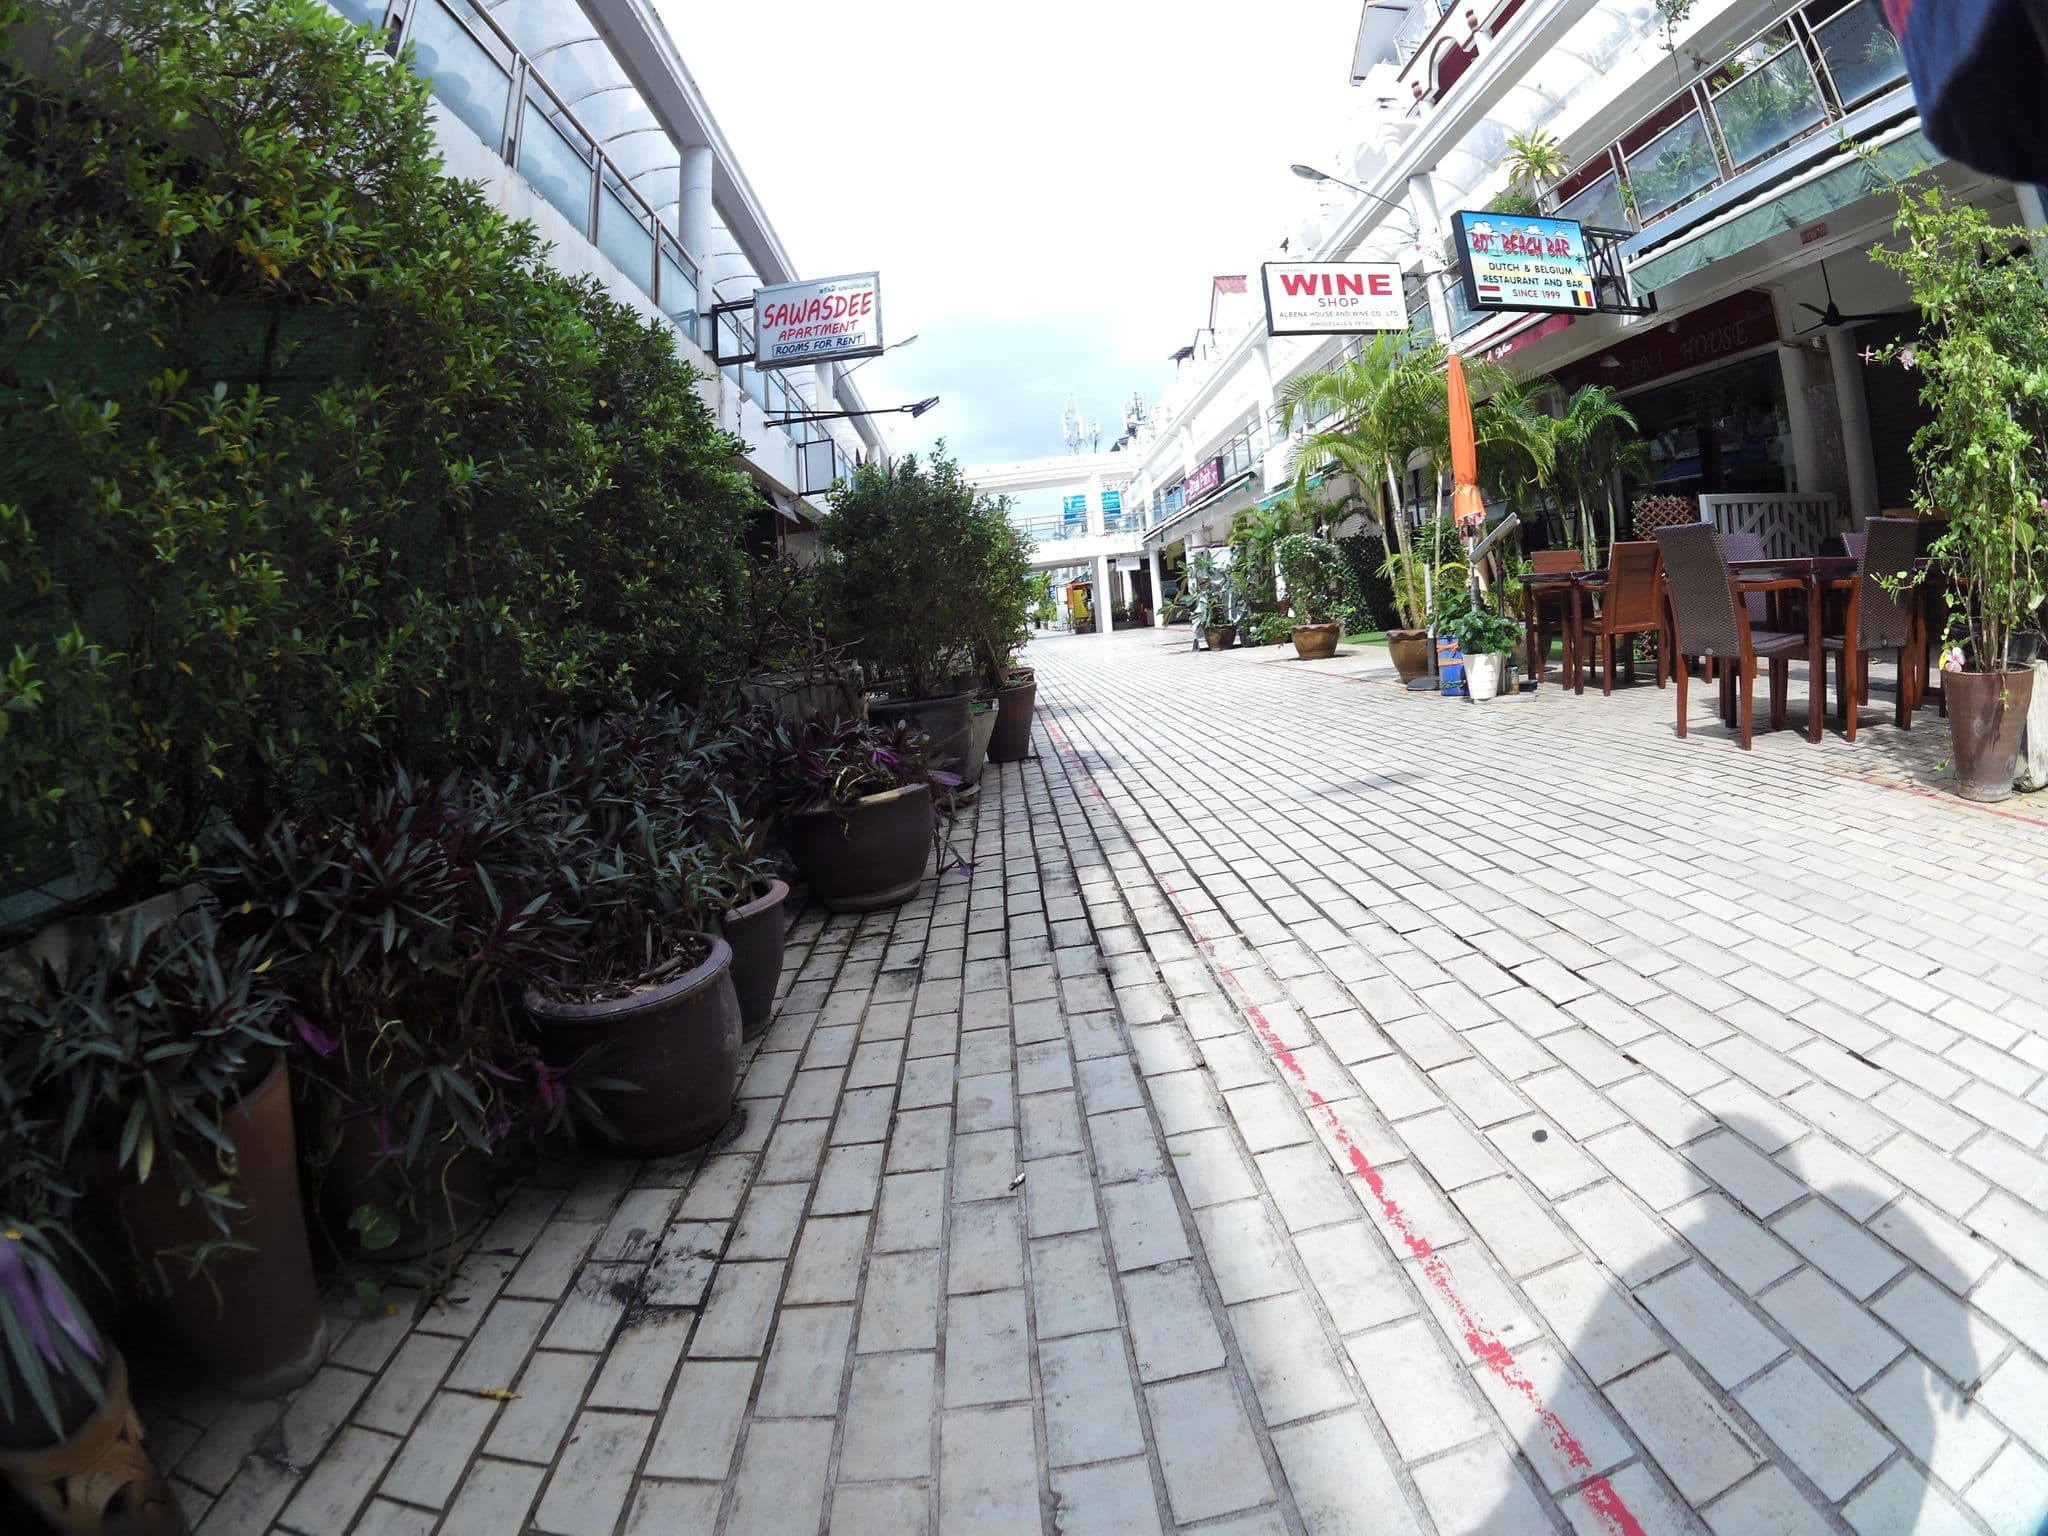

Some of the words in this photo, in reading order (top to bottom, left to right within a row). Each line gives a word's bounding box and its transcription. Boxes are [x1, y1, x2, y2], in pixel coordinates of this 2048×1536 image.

[1501, 233, 1543, 260] BEACH
[1545, 237, 1572, 259] BAR
[1488, 262, 1520, 272] DUTCH
[1524, 264, 1531, 273] &
[1534, 265, 1573, 275] BELGIUM
[1280, 273, 1393, 296] WINE
[1482, 274, 1539, 286] RESTAURANT
[1543, 278, 1563, 288] AND
[1566, 279, 1584, 288] BAR
[1317, 297, 1360, 308] SHOP
[1512, 288, 1538, 298] SINCE
[1541, 290, 1561, 299] 1999
[762, 292, 873, 329] SAWASDEE
[778, 320, 859, 341] APARTMENT
[775, 341, 810, 356] ROOMS
[813, 338, 833, 350] FOR
[836, 334, 863, 347] RENT
[1680, 319, 1748, 364] HOUSE
